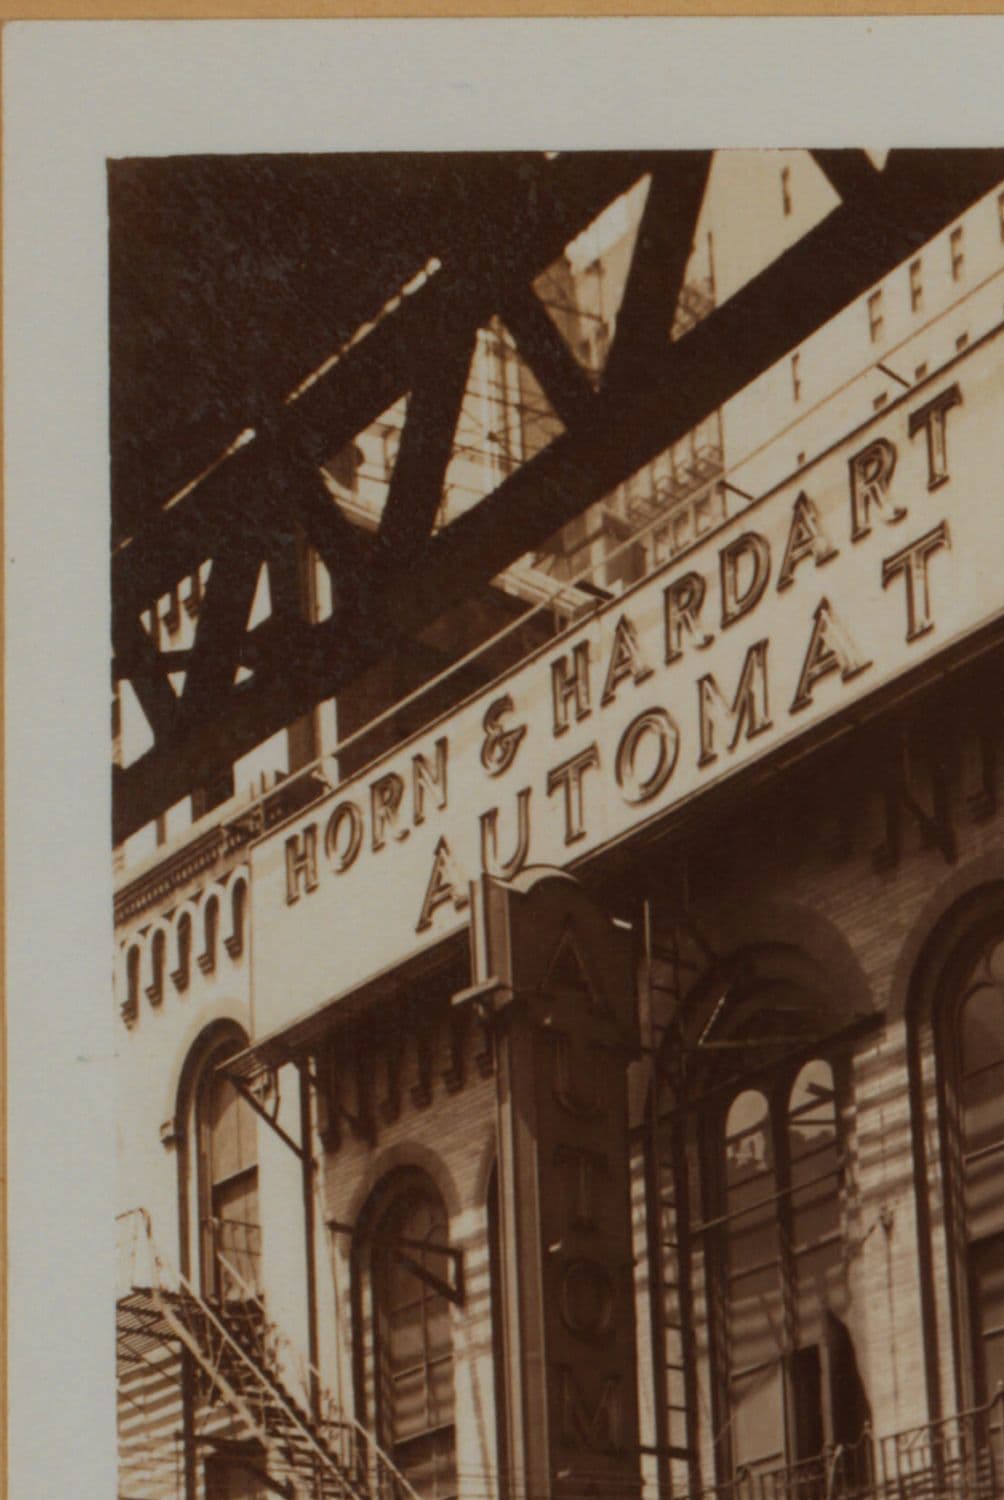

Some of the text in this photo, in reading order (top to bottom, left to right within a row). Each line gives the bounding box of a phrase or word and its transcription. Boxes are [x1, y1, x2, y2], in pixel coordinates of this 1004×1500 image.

[285, 736, 449, 906] HORN
[479, 693, 528, 778] &
[549, 383, 964, 738] HARDART
[414, 521, 952, 935] AUTOMAT
